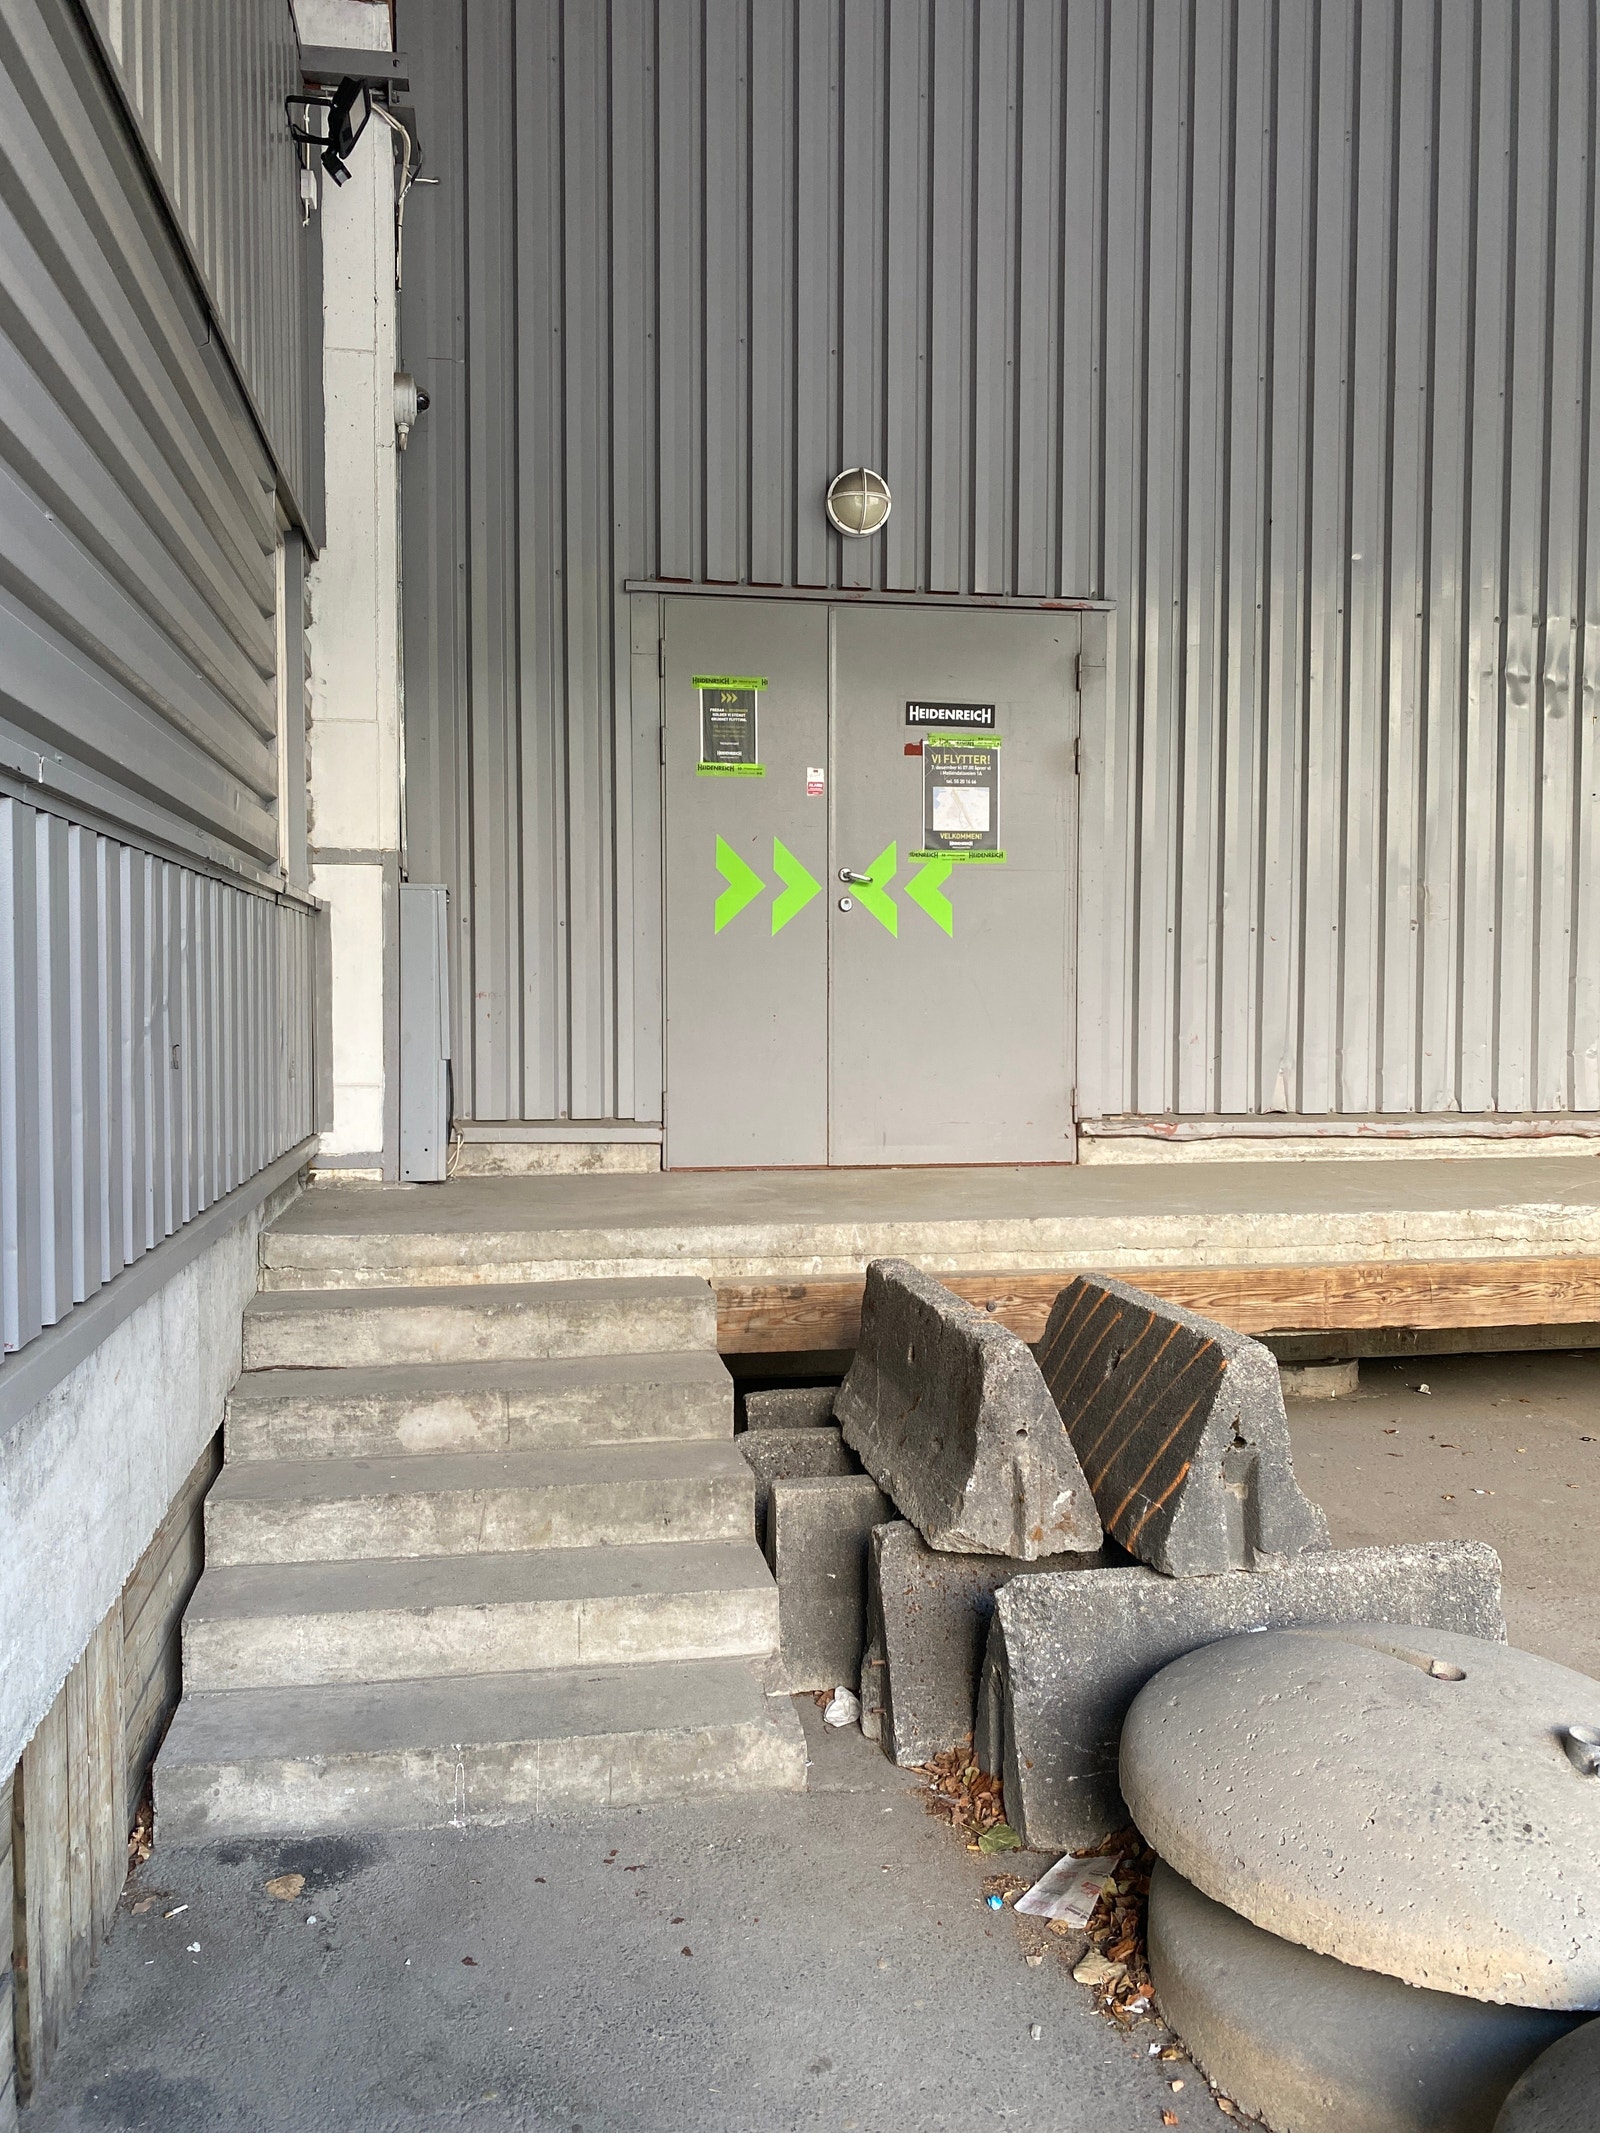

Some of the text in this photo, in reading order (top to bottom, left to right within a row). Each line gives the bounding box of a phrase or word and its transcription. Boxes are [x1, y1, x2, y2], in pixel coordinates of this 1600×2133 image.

[909, 705, 991, 724] HEIDENREICH
[931, 754, 991, 765] VI FLYTTER!
[940, 832, 983, 840] VELKOMMEN!
